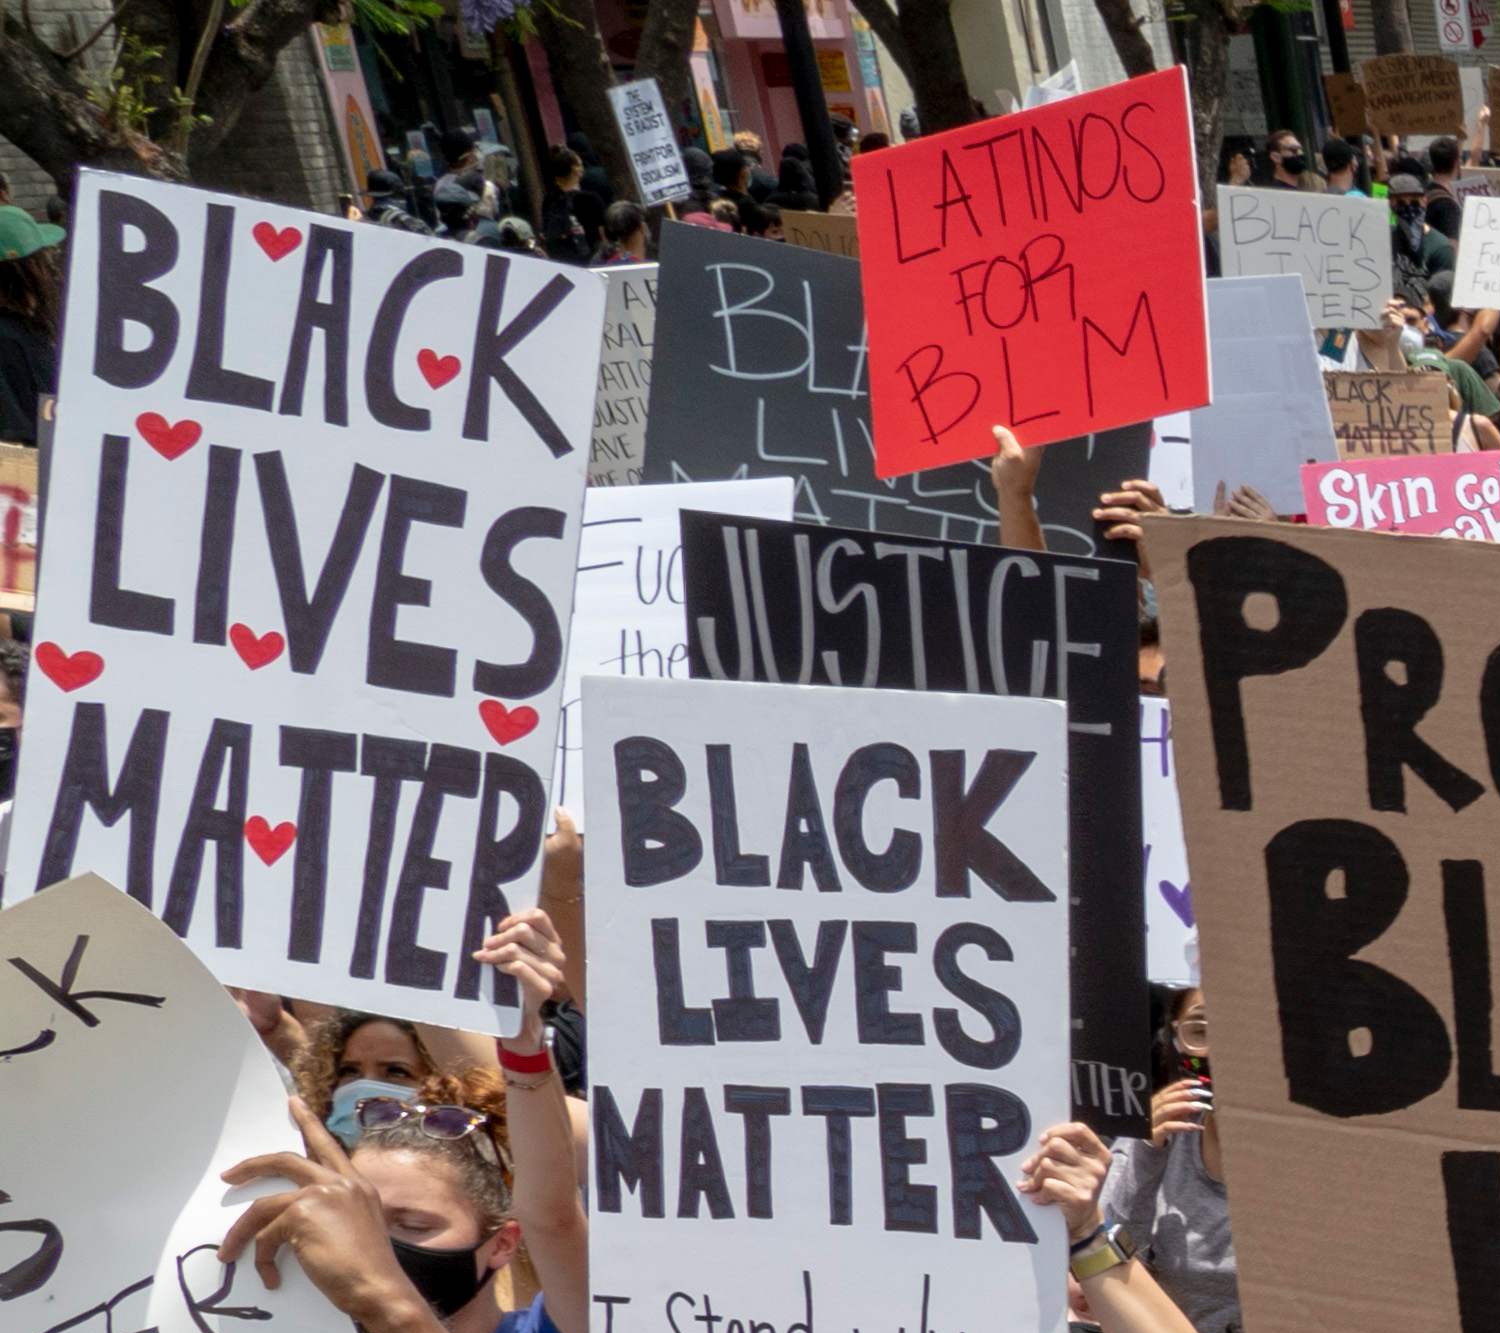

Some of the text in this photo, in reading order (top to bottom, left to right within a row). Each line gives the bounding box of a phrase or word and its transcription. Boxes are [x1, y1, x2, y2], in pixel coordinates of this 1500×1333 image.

[885, 103, 1166, 264] LATINOS
[1230, 193, 1368, 254] BLACK
[93, 189, 576, 459] BLACK
[951, 233, 1076, 337] FOR
[897, 290, 1170, 446] BLM
[1366, 403, 1436, 434] LIVES
[89, 433, 567, 700] LIVES
[1319, 467, 1438, 531] Skin
[697, 525, 1112, 736] JUSTICE
[35, 701, 546, 1009] MATTER
[613, 735, 1057, 902] BLACK
[650, 917, 1022, 1070] LIVES
[592, 1081, 1039, 1245] MATTER
